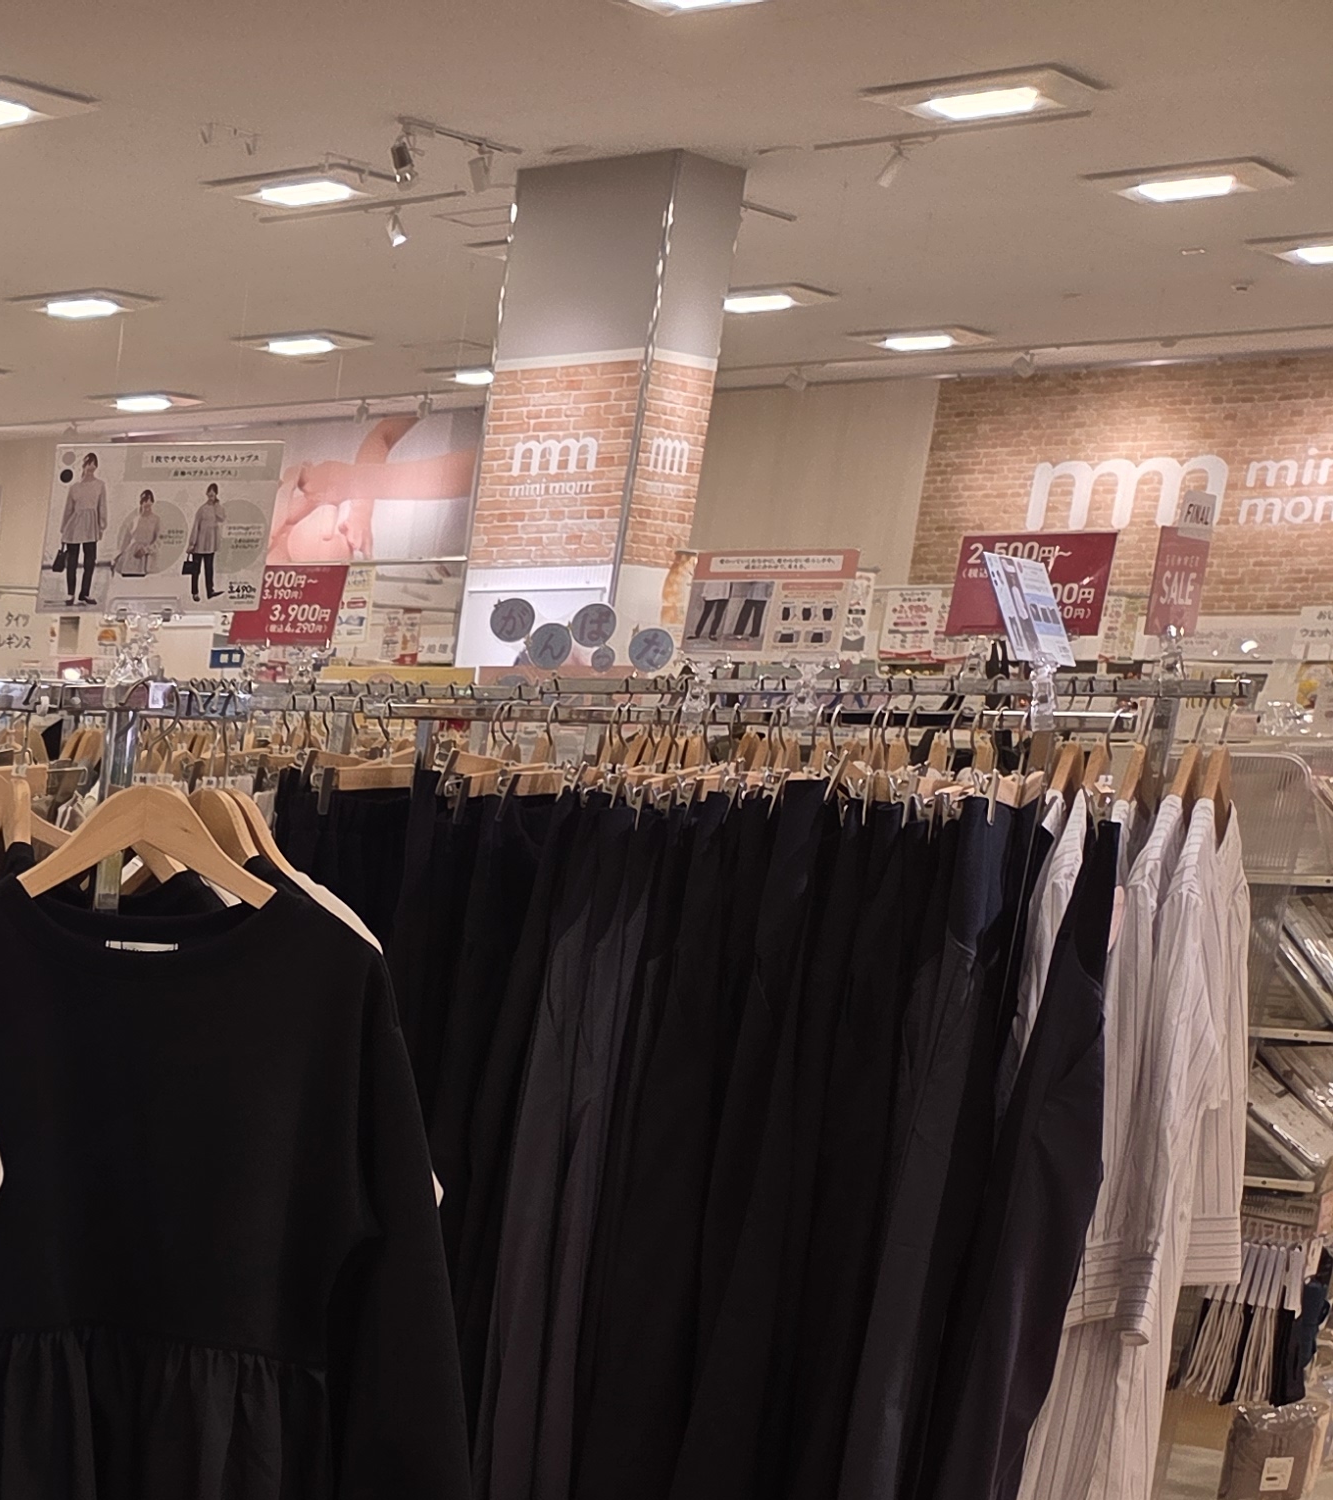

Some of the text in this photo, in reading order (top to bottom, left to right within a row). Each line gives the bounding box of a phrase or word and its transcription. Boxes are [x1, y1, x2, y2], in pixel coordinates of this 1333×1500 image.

[509, 478, 594, 497] mini mom
[1184, 503, 1211, 526] FINAL
[967, 542, 1073, 564] 2500円～
[263, 570, 319, 589] 900円～
[1159, 570, 1197, 606] SALE
[4, 612, 31, 628] タイツ
[269, 604, 332, 623] 3,900円
